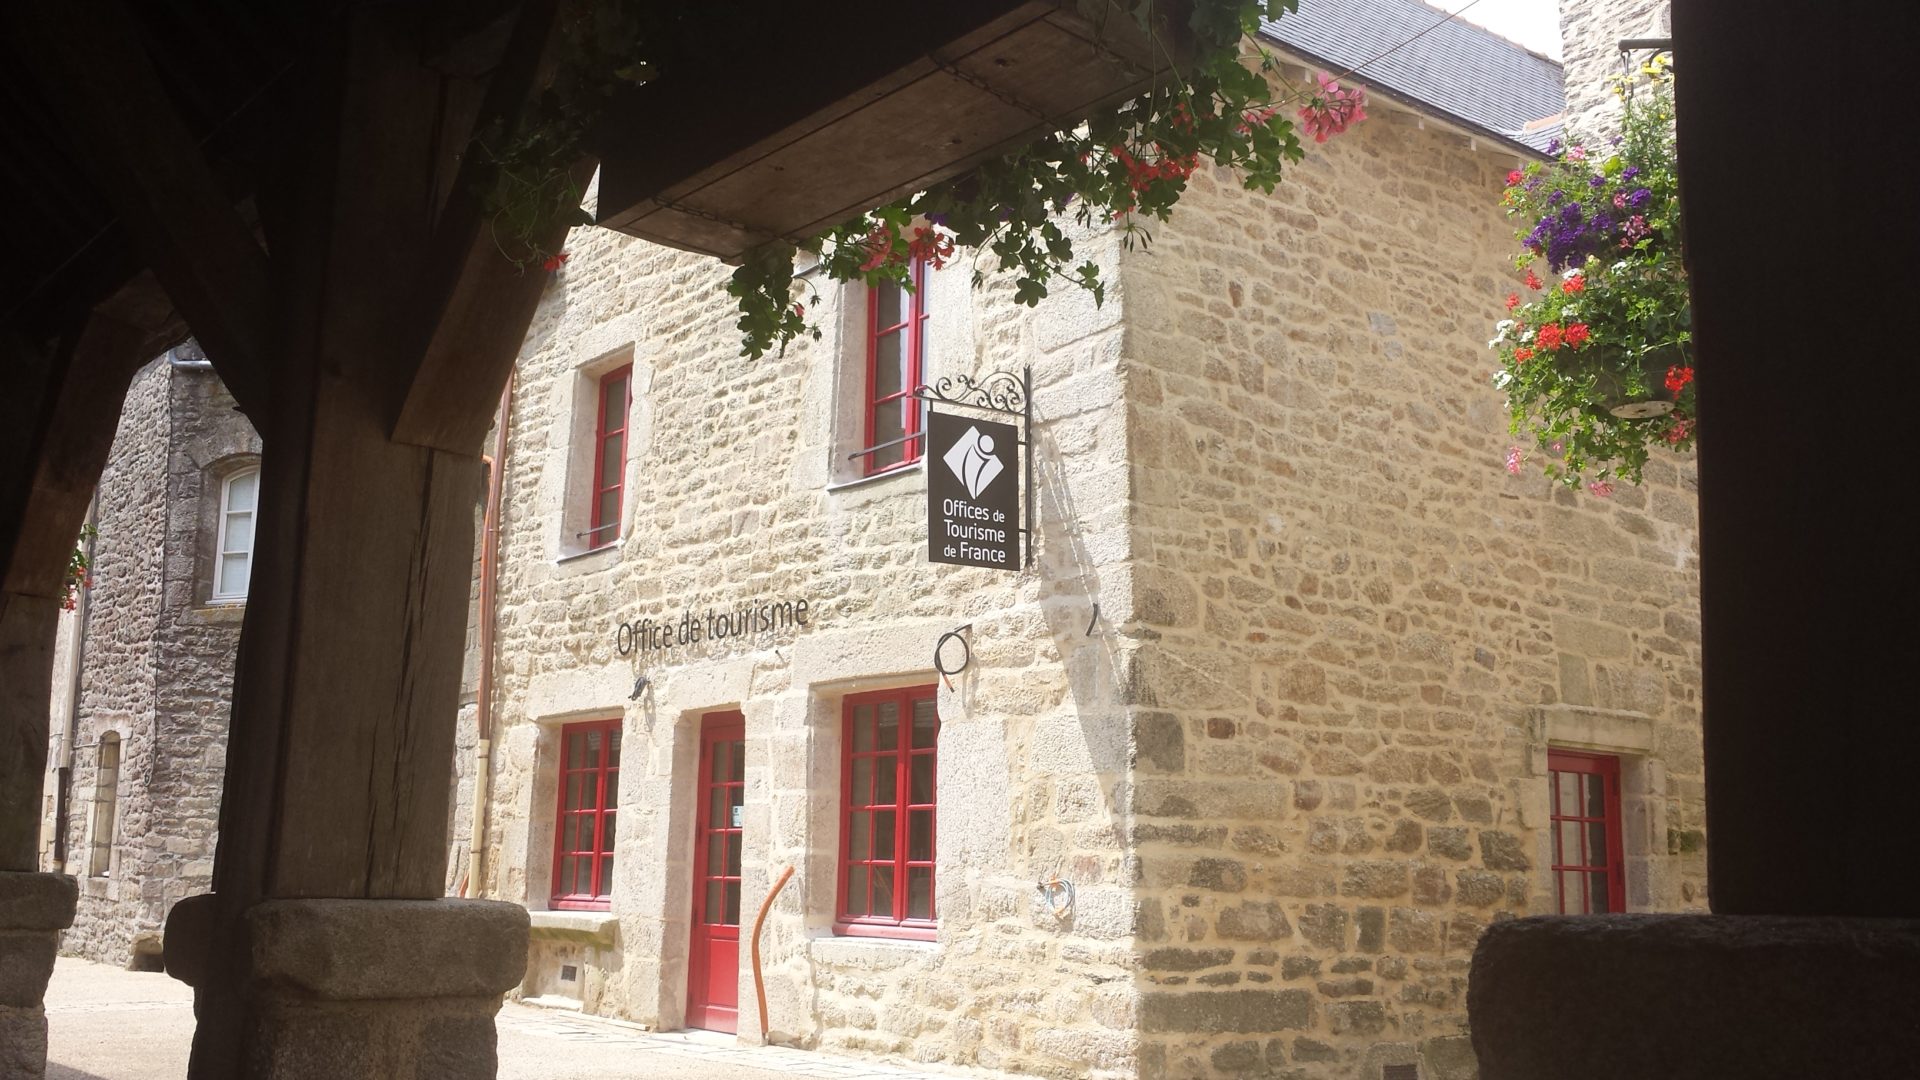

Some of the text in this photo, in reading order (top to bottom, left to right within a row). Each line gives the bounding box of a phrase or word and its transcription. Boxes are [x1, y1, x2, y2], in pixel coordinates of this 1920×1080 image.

[943, 498, 1005, 523] Offices de
[943, 519, 1005, 543] Tourisme
[944, 542, 1006, 563] de France
[617, 598, 809, 656] Office de tourisme
